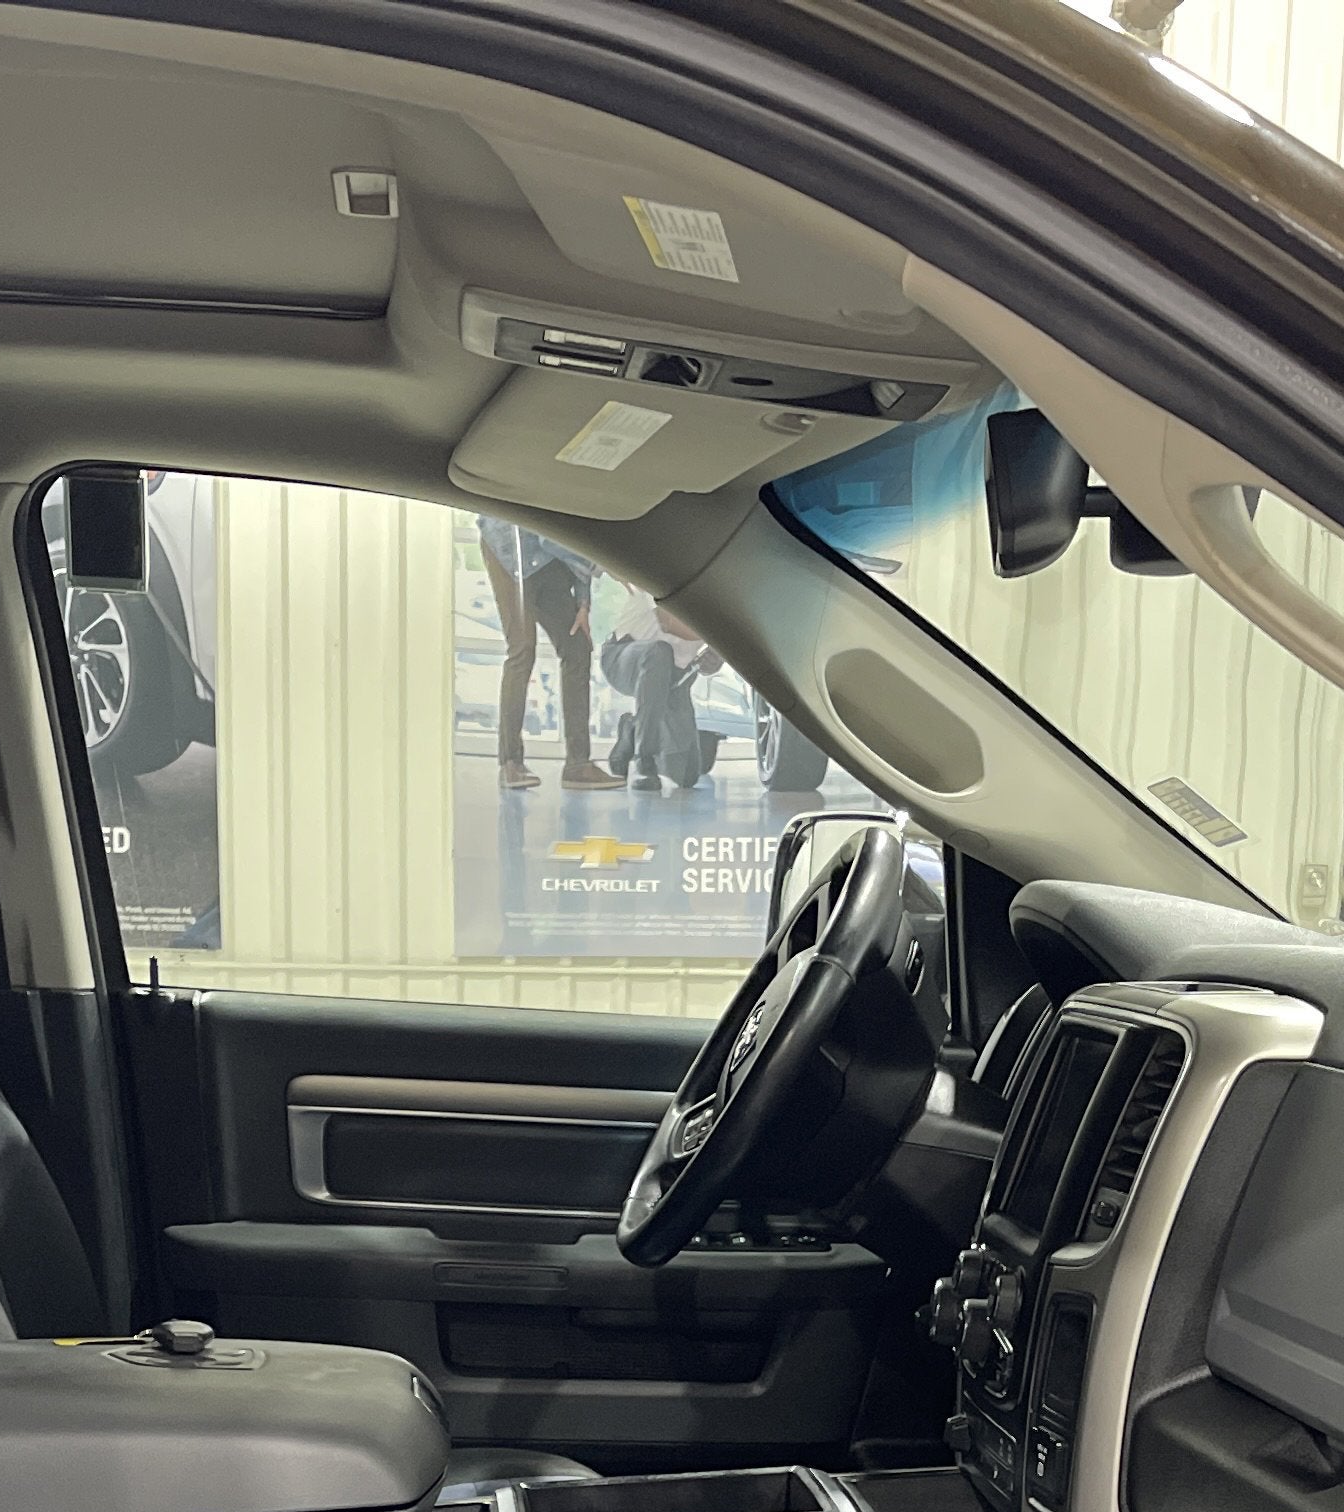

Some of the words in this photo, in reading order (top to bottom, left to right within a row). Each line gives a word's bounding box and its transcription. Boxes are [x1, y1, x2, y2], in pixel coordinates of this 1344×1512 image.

[683, 837, 778, 862] CERTIF
[542, 878, 661, 893] CHEVROLET
[682, 868, 774, 893] SERVIC
